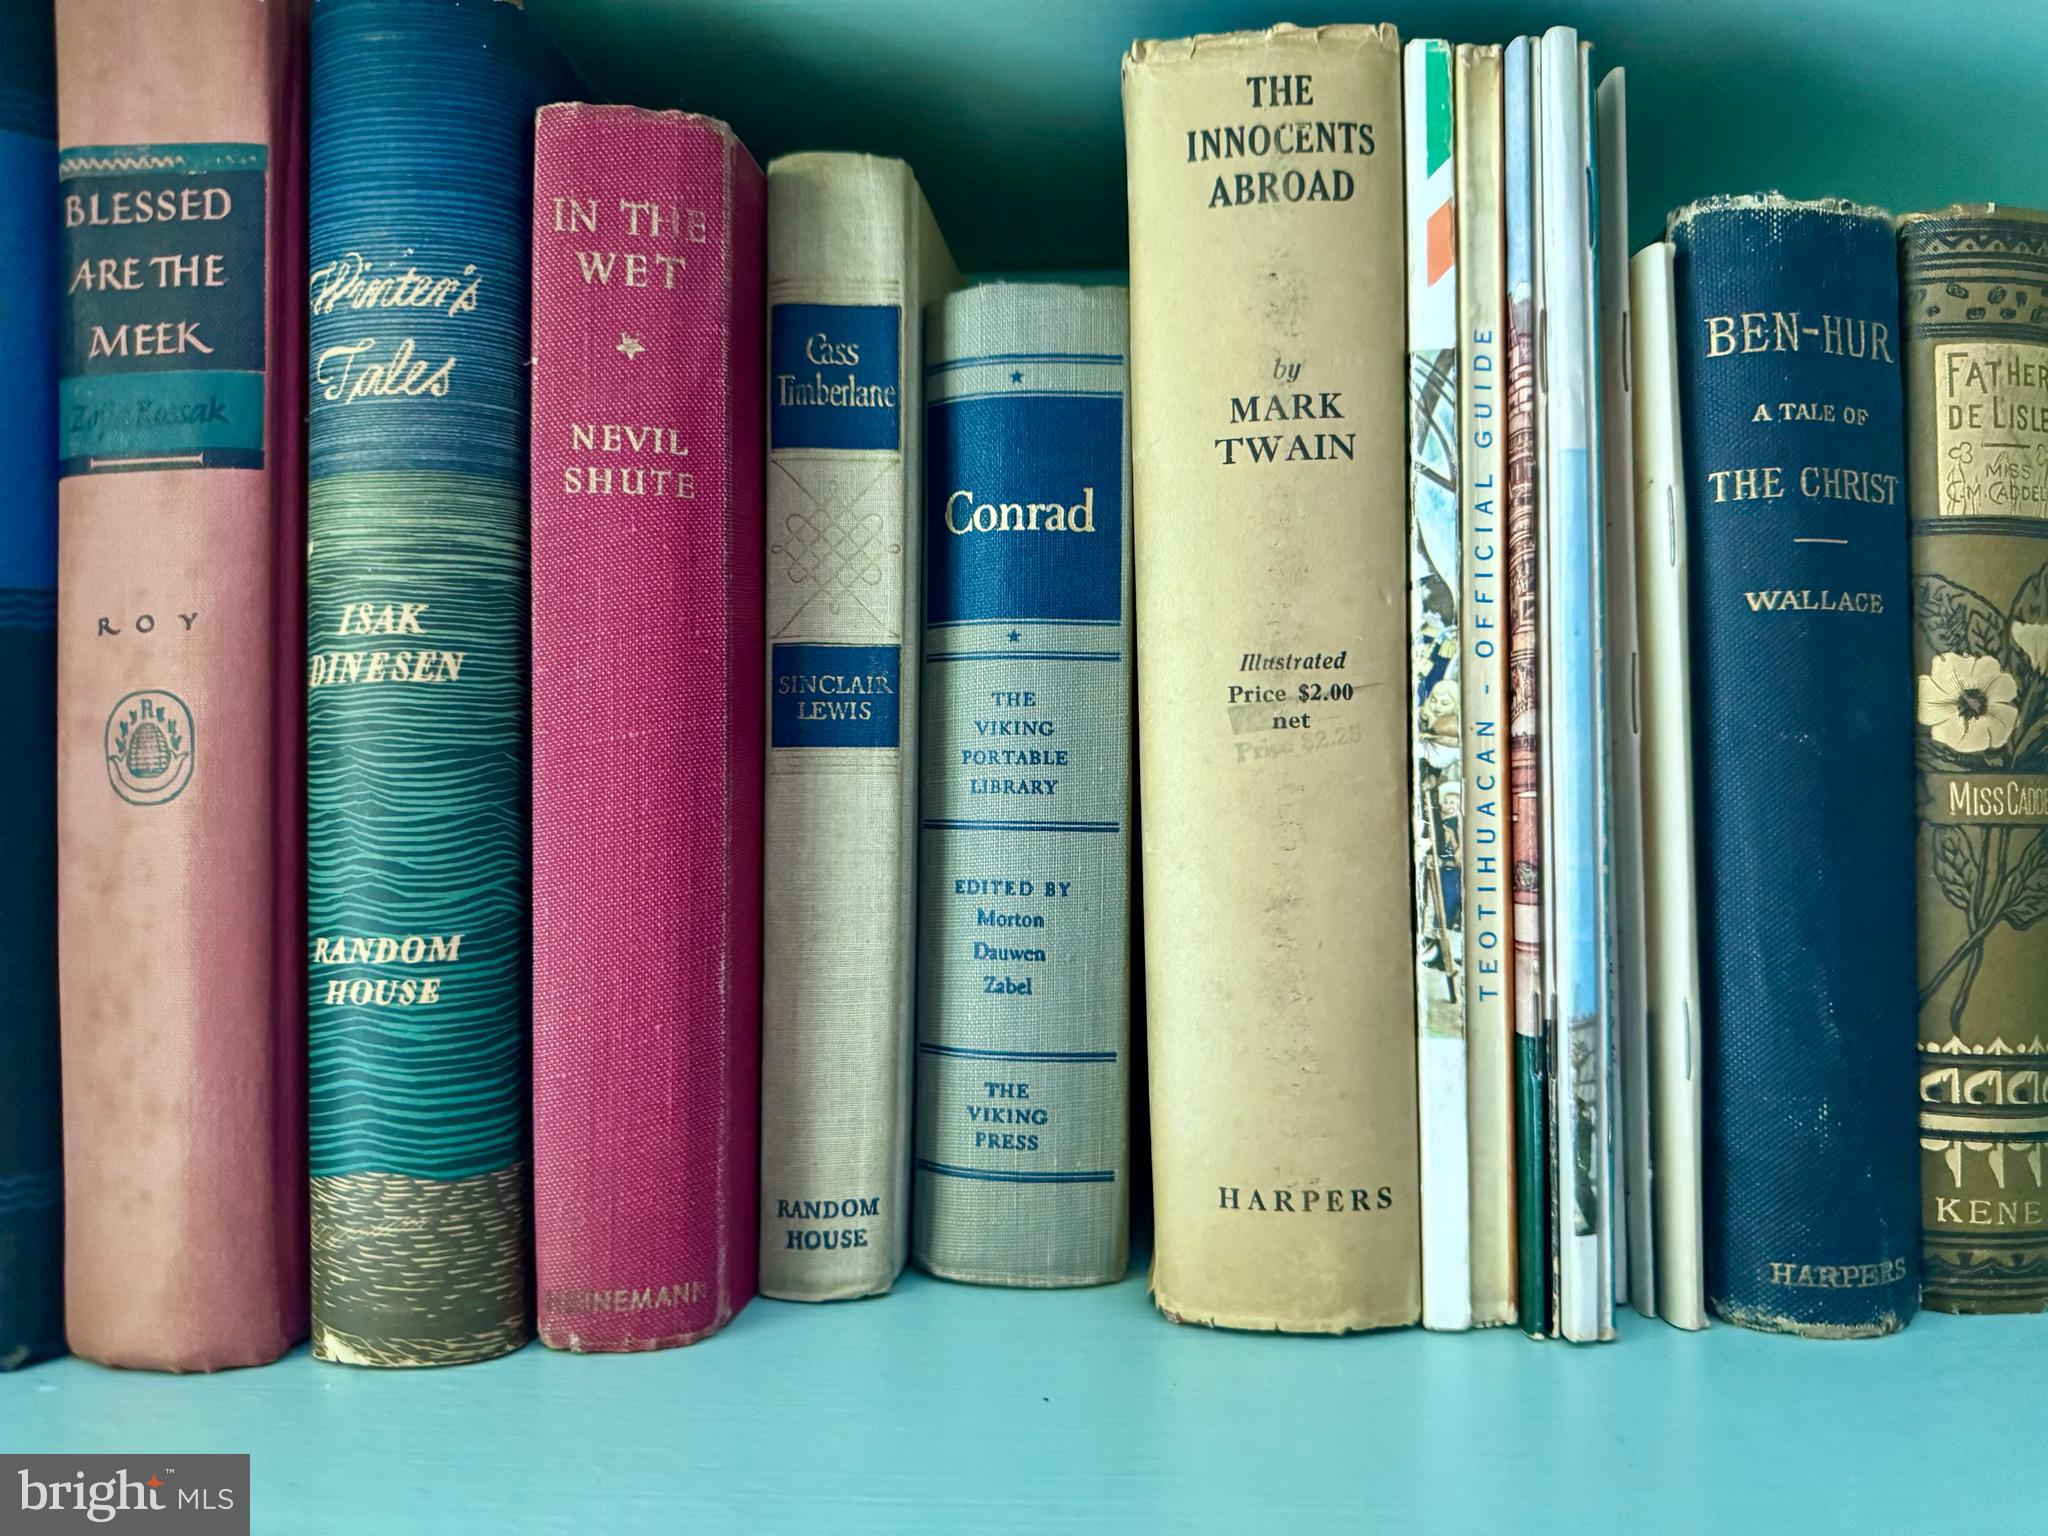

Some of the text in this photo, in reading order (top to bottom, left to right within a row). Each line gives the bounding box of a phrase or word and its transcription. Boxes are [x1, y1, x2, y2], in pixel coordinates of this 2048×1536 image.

[1247, 75, 1313, 107] THE
[1187, 122, 1375, 163] INNOCENTS
[1209, 170, 1354, 208] ABROAD
[65, 187, 231, 228] BLESSED
[553, 198, 707, 244] IN THE
[69, 254, 227, 294] ARE THE
[310, 251, 482, 317] Winter's
[577, 251, 687, 289] WET
[89, 321, 214, 359] MEEK
[806, 333, 860, 366] Cass
[1704, 311, 1895, 364] BEN-HUR
[318, 337, 457, 404] Tales
[1273, 358, 1301, 382] by
[1947, 352, 2048, 397] FATHER
[776, 371, 896, 408] Timberlane
[1474, 328, 1494, 449] GUIDE
[1230, 392, 1346, 424] MARK
[1751, 403, 1869, 427] A TALE OF
[1948, 396, 2048, 433] DE LISLE
[571, 424, 689, 455] NEVIL
[1215, 434, 1356, 465] TWAIN
[564, 467, 696, 499] SHUTE
[1986, 461, 2032, 480] MISS
[1708, 466, 1899, 506] THE CHRIST
[945, 487, 1096, 535] Conrad
[1474, 474, 1495, 660] OFFICIAL
[1743, 591, 1884, 614] WALLACE
[98, 611, 199, 636] ROY
[337, 603, 430, 635] ISAK
[309, 651, 466, 688] DINESEN
[1239, 650, 1347, 672] Illustrated
[778, 674, 894, 696] SINCLAIR
[991, 691, 1037, 707] THE
[1228, 683, 1354, 704] Price $2.00
[797, 701, 872, 720] LEWIS
[1272, 713, 1311, 729] net
[974, 720, 1055, 737] VIKING
[961, 749, 1068, 767] PORTABLE
[970, 779, 1058, 796] LIBRARY
[1477, 720, 1498, 1002] TEOTIHUACAN
[955, 879, 1072, 897] EDITED BY
[976, 909, 1045, 928] Morton
[314, 935, 462, 964] RANDOM
[973, 943, 1046, 962] Dauwen
[326, 978, 441, 1006] HOUSE
[983, 976, 1033, 996] Zabel
[984, 1082, 1030, 1098] THE
[966, 1107, 1048, 1126] VIKING
[975, 1133, 1039, 1150] PRESS
[778, 1198, 881, 1219] RANDOM
[1218, 1186, 1392, 1212] HARPERS
[1935, 1197, 2042, 1225] KENE
[786, 1229, 868, 1250] HOUSE
[1769, 1257, 1907, 1288] HARPERS
